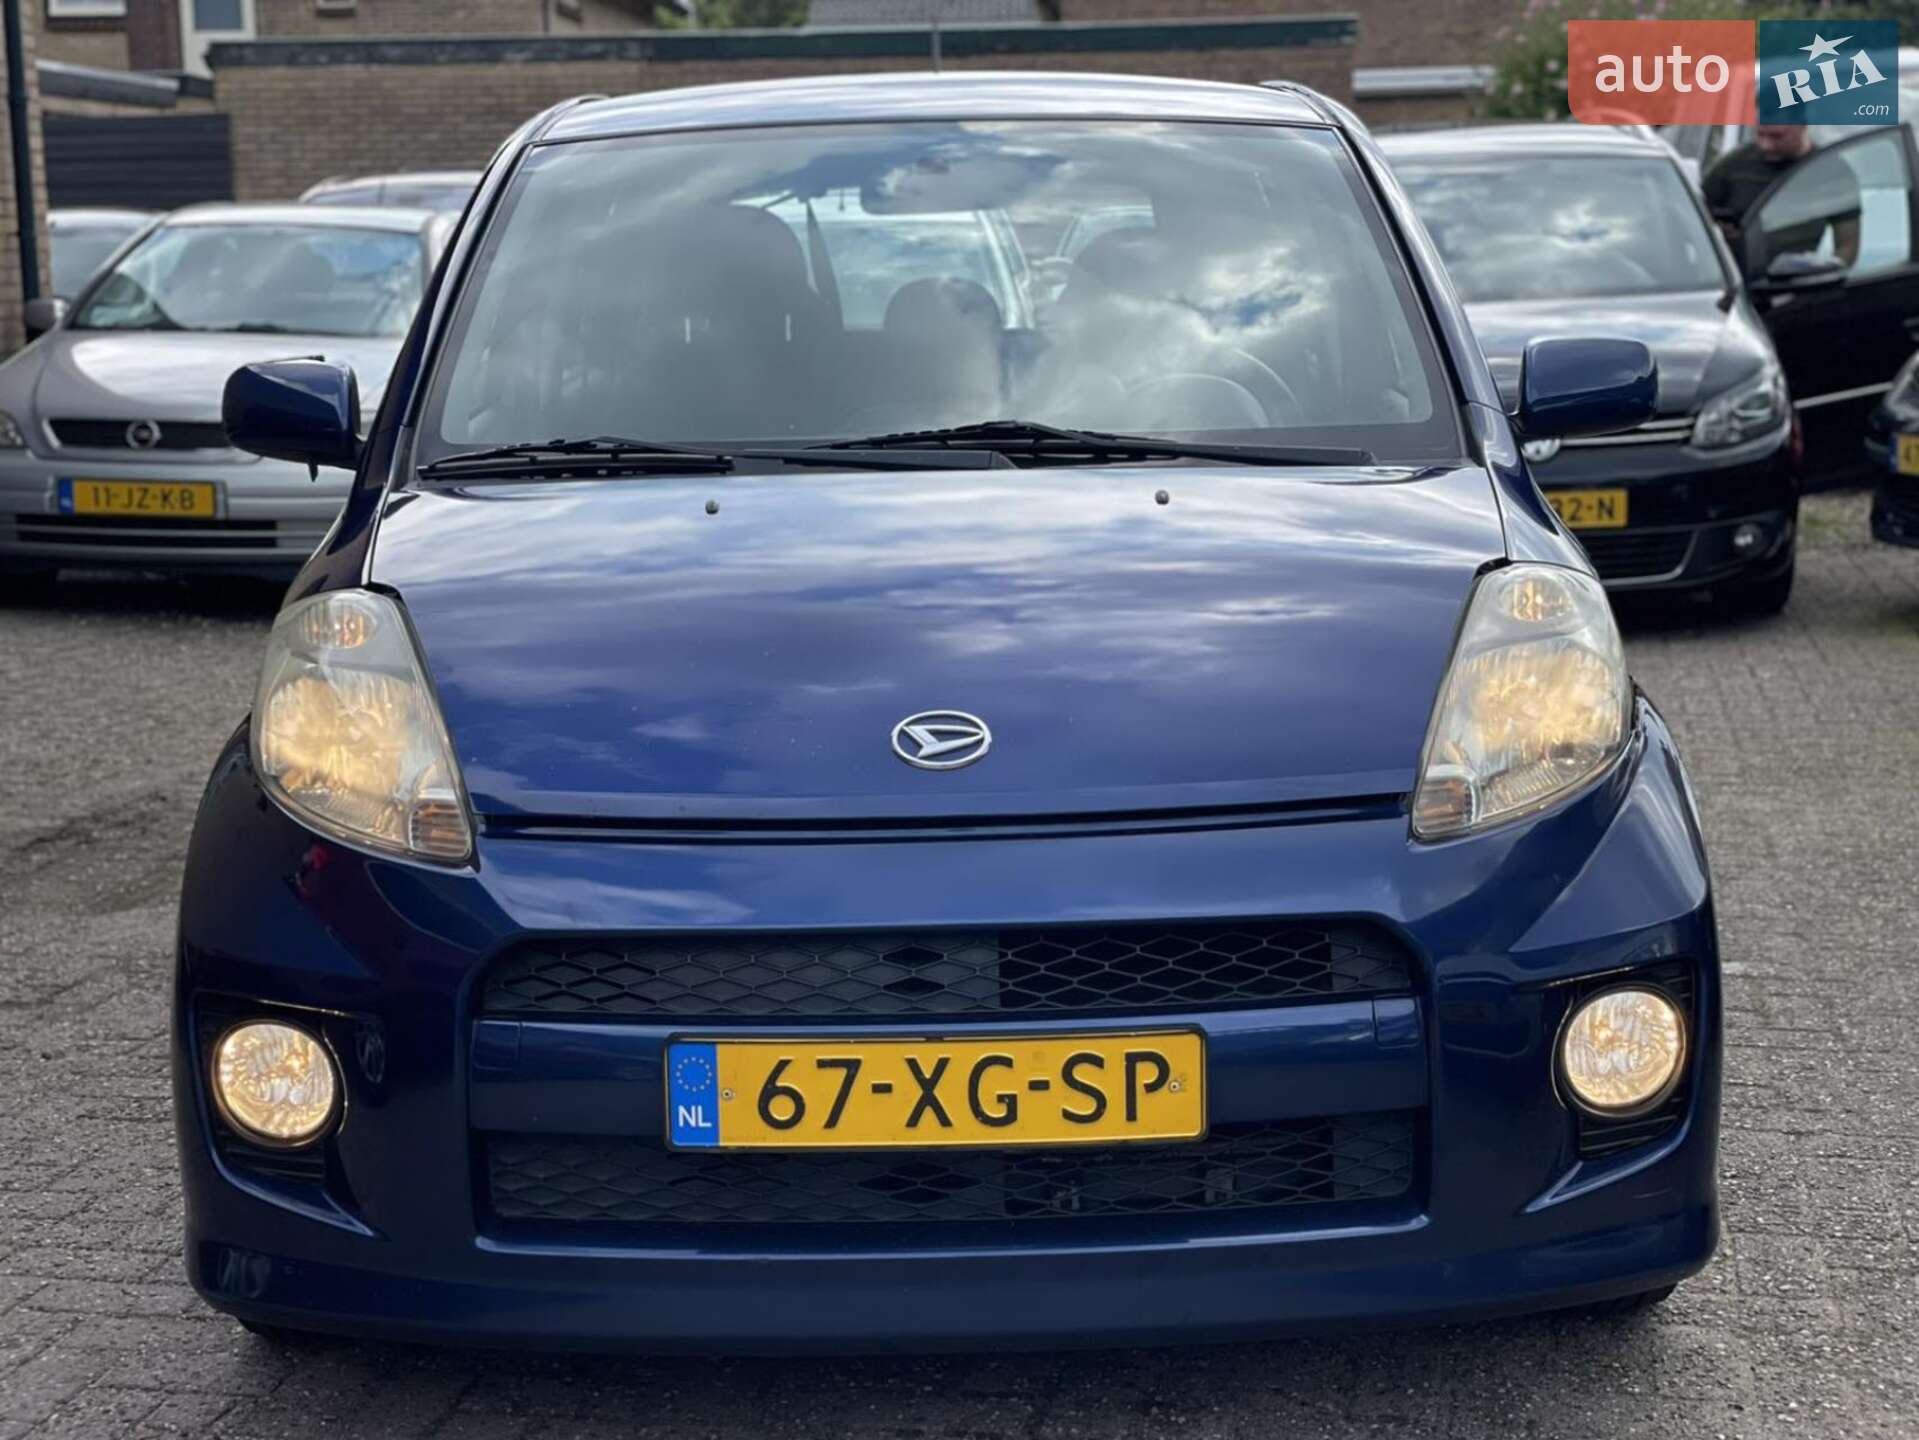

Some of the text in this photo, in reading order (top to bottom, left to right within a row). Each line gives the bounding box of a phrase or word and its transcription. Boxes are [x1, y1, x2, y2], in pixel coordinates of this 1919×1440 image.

[91, 486, 196, 511] 11-JZ-KB
[756, 1050, 1172, 1131] 67-XG-SP
[677, 1104, 713, 1128] NL
